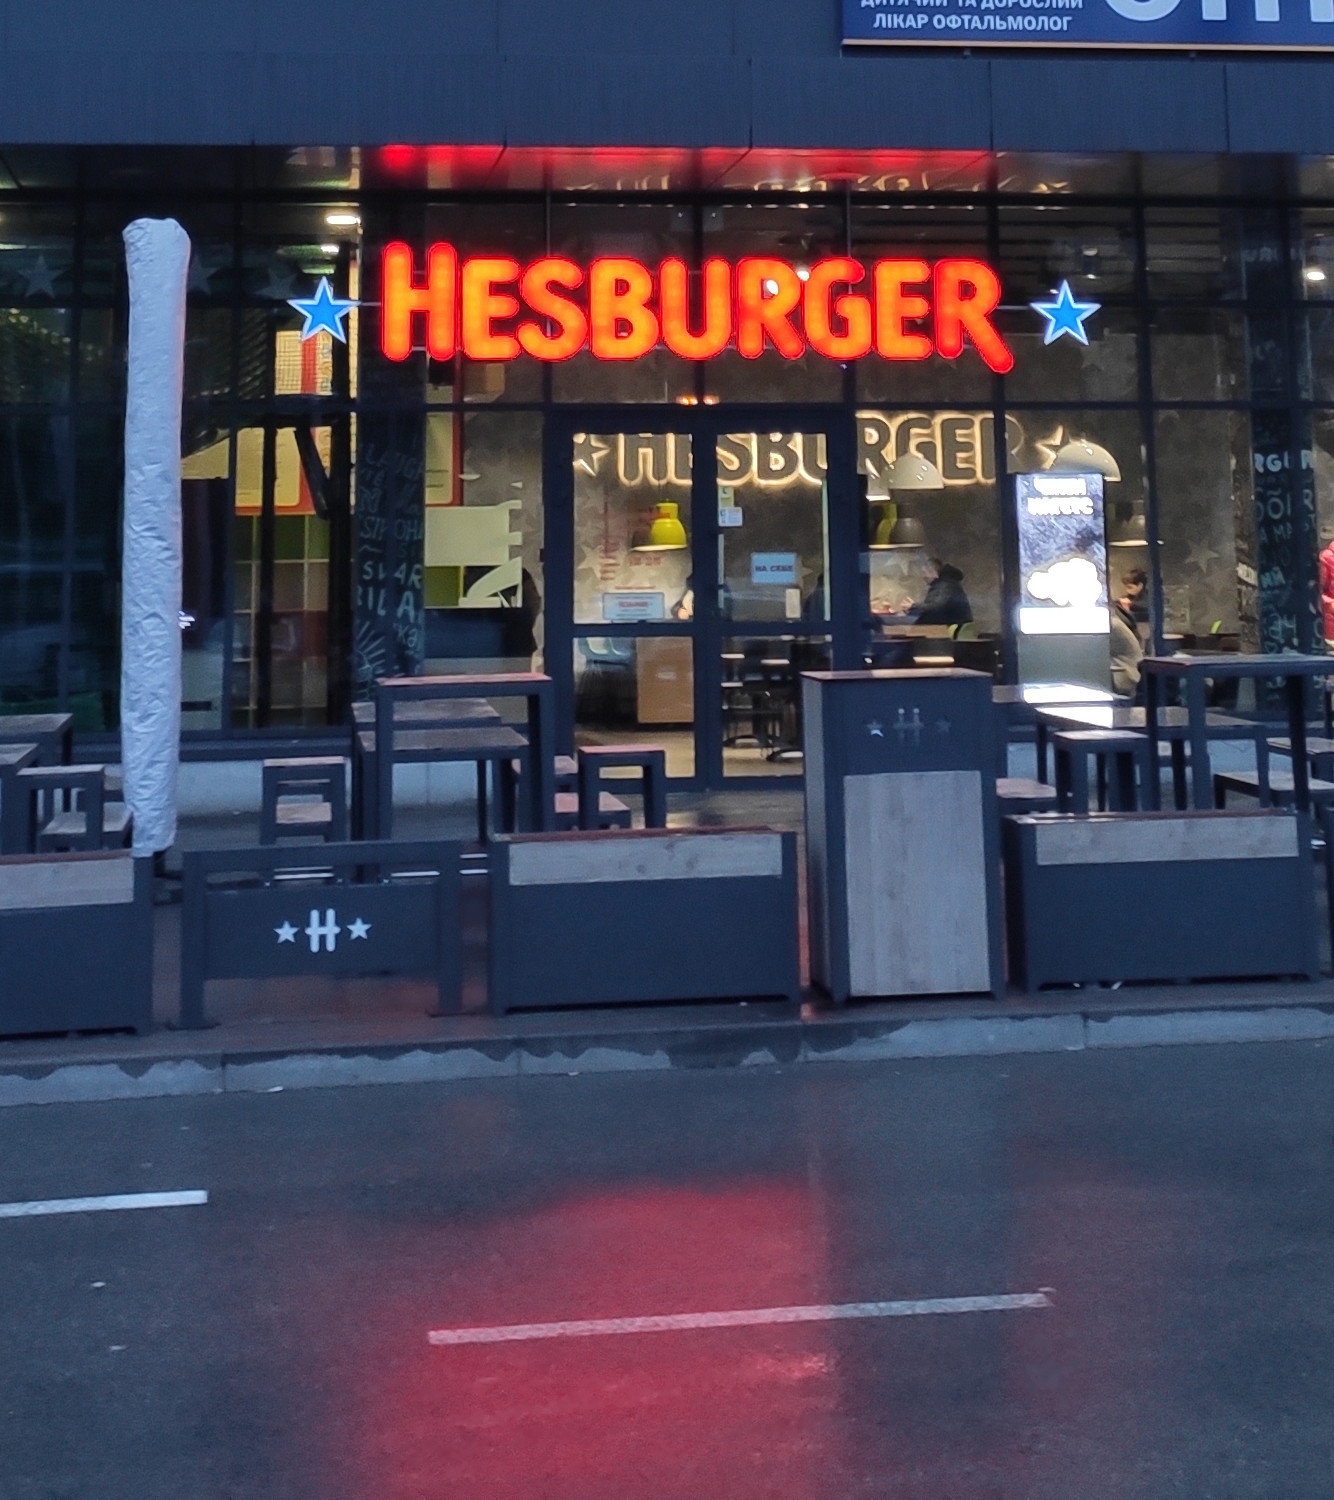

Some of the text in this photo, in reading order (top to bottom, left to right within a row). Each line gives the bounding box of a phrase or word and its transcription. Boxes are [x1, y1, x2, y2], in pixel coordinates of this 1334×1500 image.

[873, 13, 1073, 31] ЛІКАР ОФТАЛЬМОЛОГ
[380, 241, 1015, 375] HESBURGER
